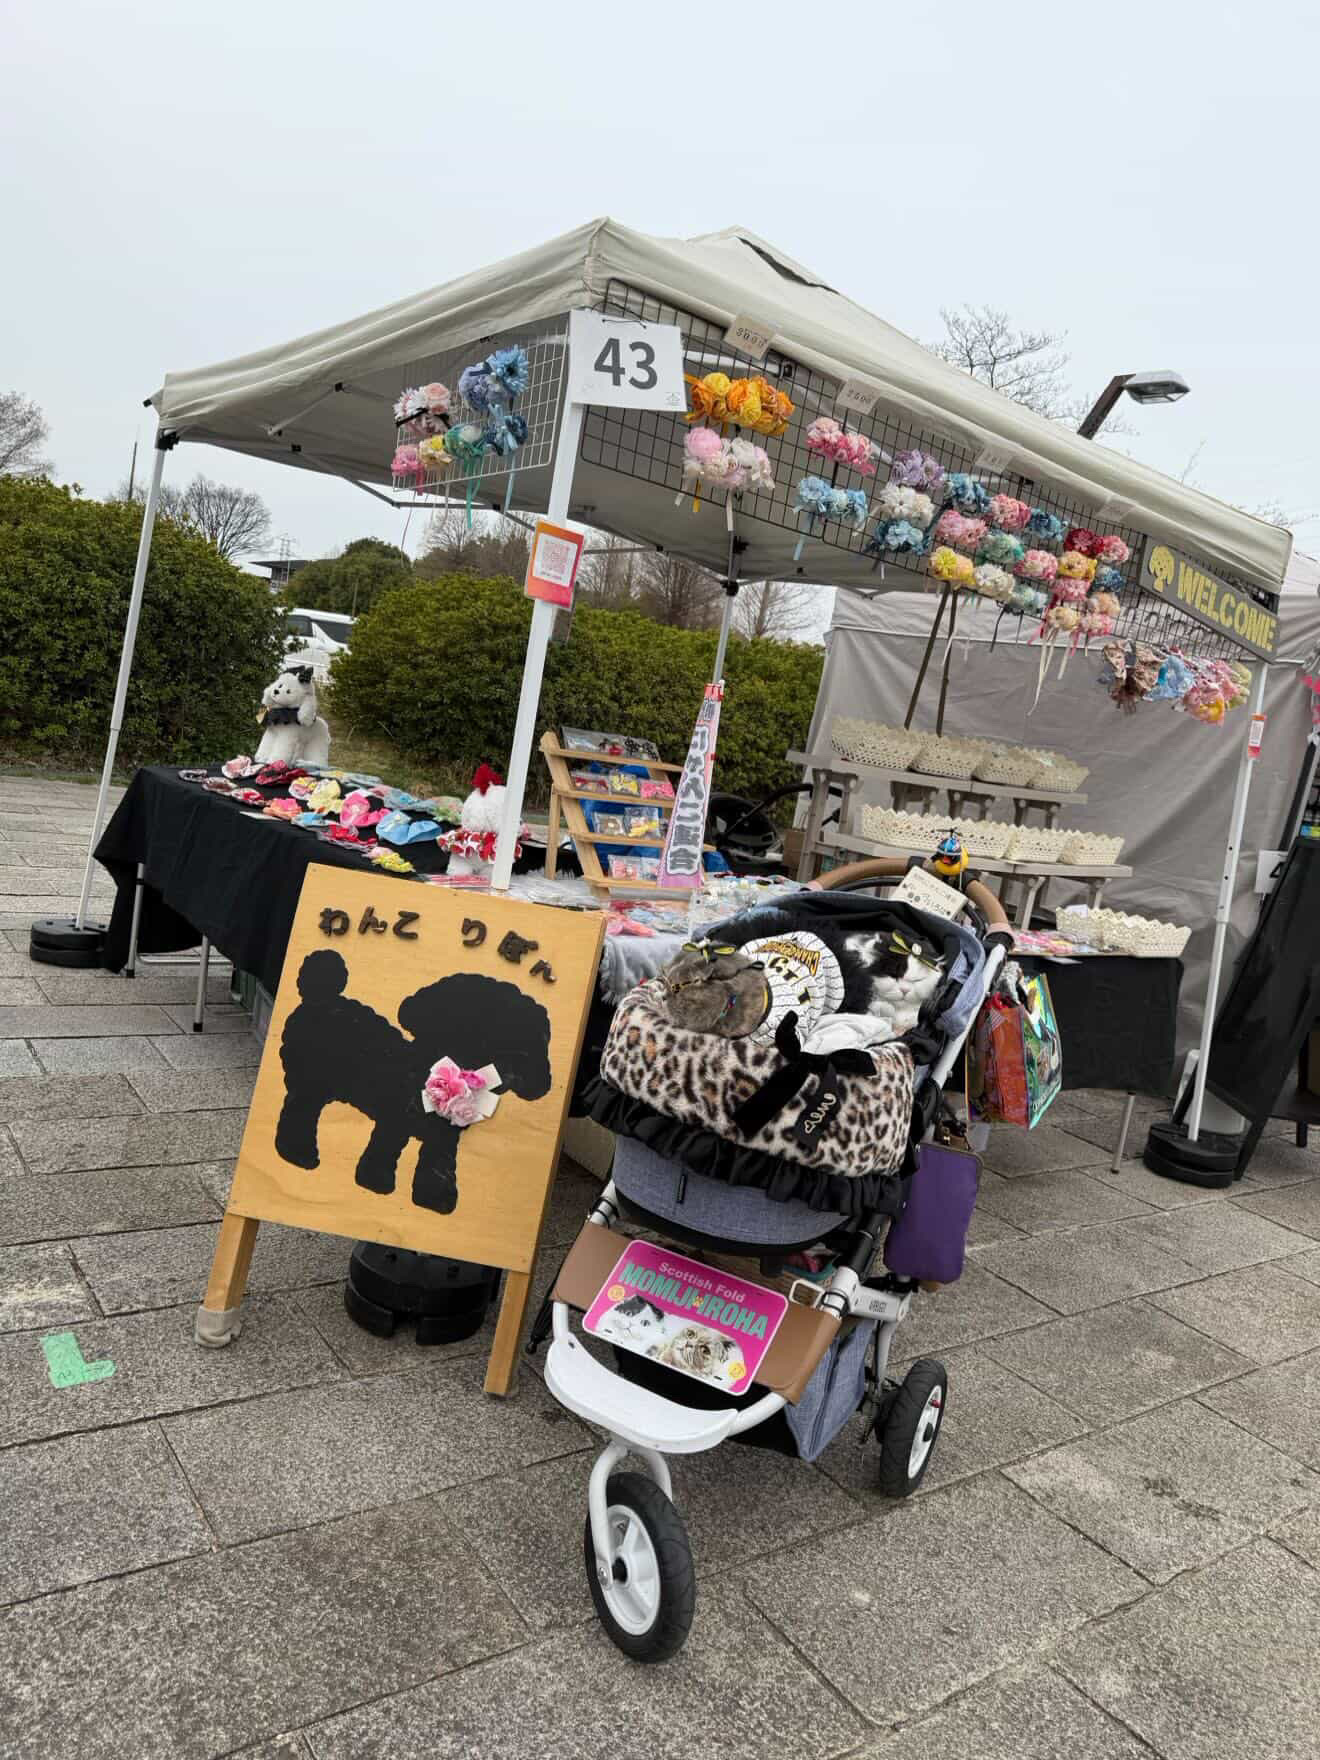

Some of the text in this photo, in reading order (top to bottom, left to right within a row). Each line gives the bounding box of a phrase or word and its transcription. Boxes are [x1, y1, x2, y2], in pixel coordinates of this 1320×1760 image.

[594, 338, 658, 390] 43
[1176, 562, 1274, 651] WELCOME
[319, 906, 421, 940] わんこ
[659, 1262, 746, 1303] Scottish Fold
